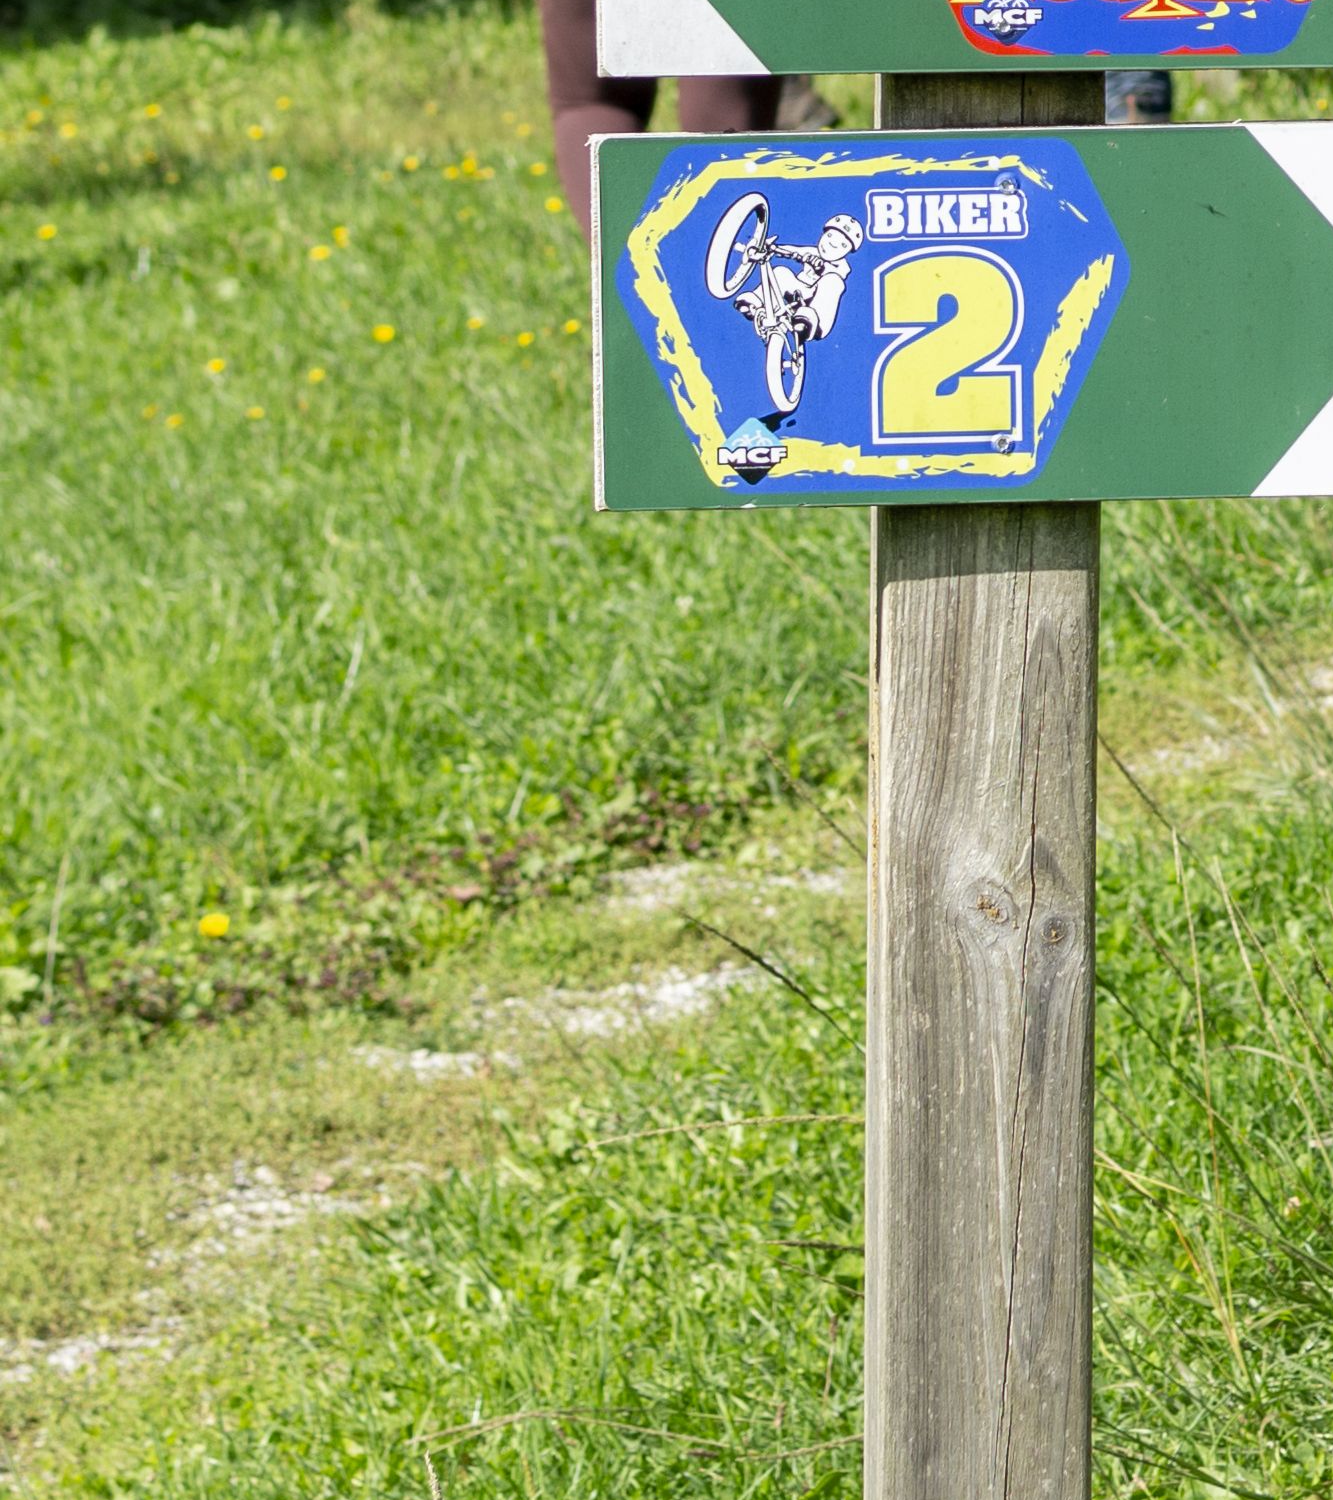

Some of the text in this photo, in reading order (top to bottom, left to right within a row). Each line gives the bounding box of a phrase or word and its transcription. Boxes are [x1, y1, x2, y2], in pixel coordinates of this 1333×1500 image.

[973, 8, 1044, 25] MCF
[871, 192, 1023, 236] BIKER
[874, 247, 1022, 442] 2
[718, 447, 788, 465] MCF
